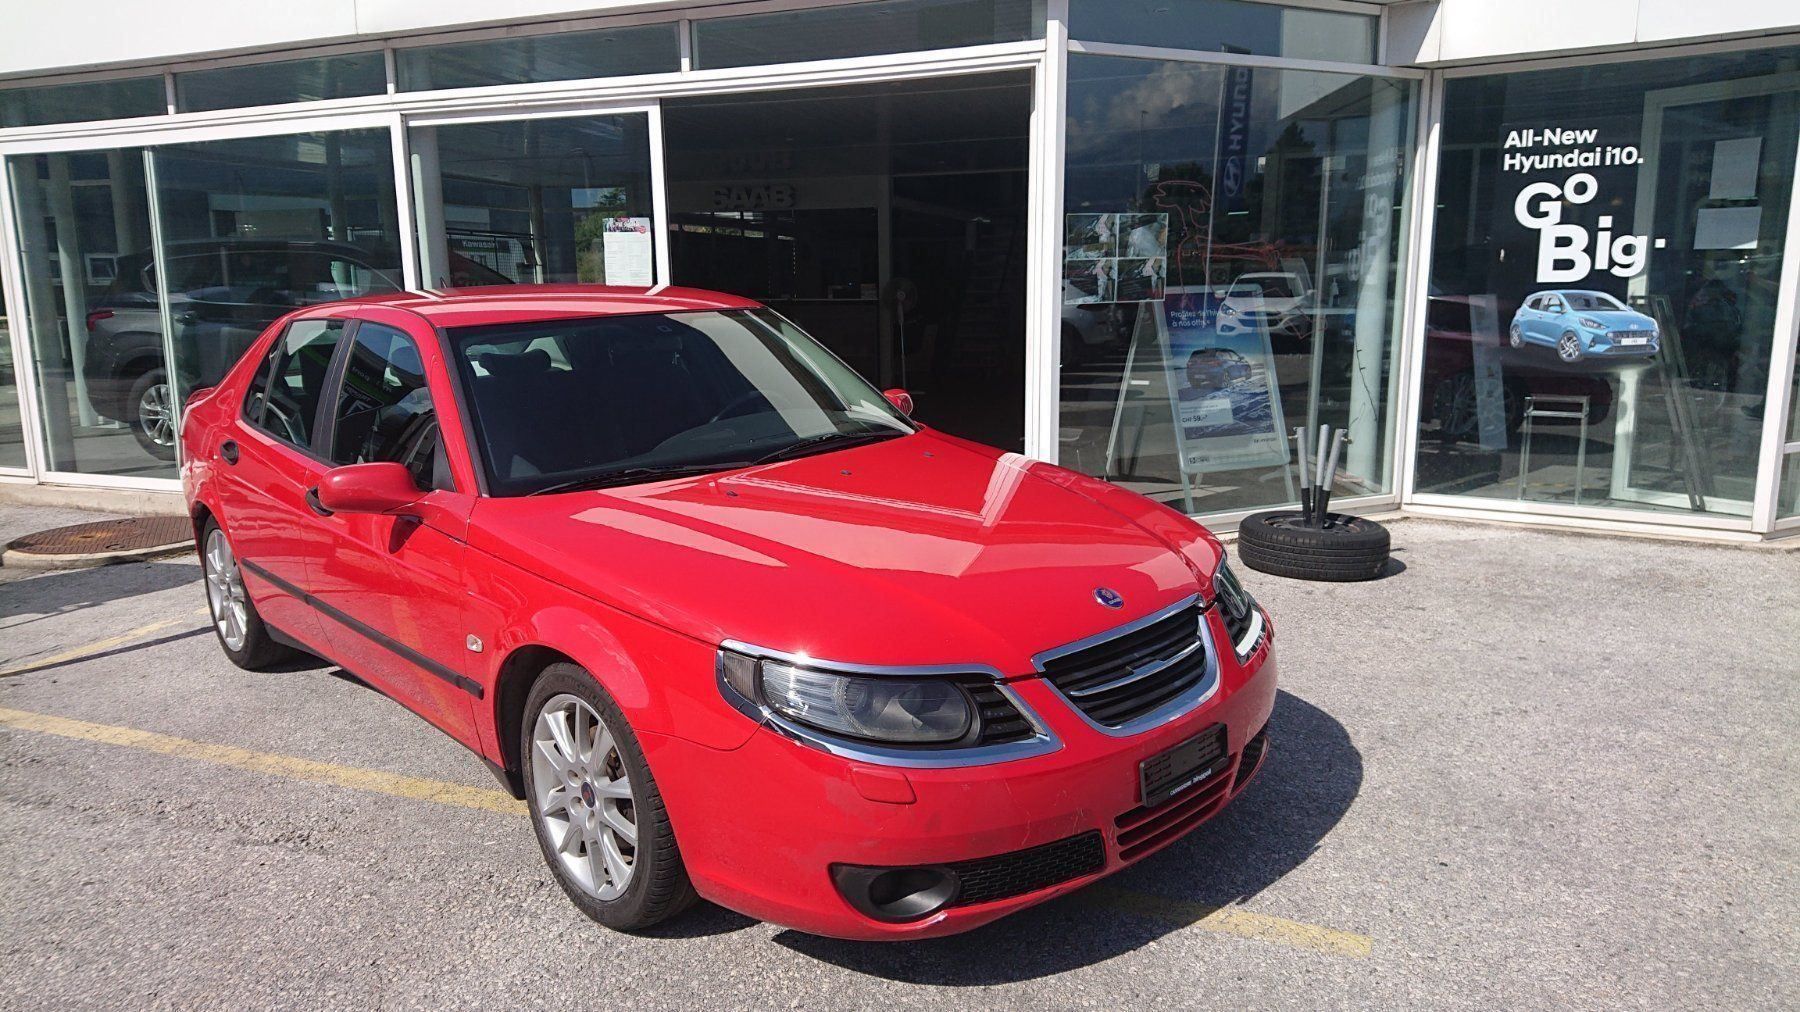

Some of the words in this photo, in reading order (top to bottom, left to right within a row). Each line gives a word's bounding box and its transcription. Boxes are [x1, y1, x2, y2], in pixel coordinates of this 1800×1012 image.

[1229, 66, 1248, 150] HYUND
[1503, 127, 1598, 149] All-New
[1503, 147, 1601, 174] Hyundai
[1604, 146, 1644, 166] i10.
[1514, 172, 1598, 230] Go
